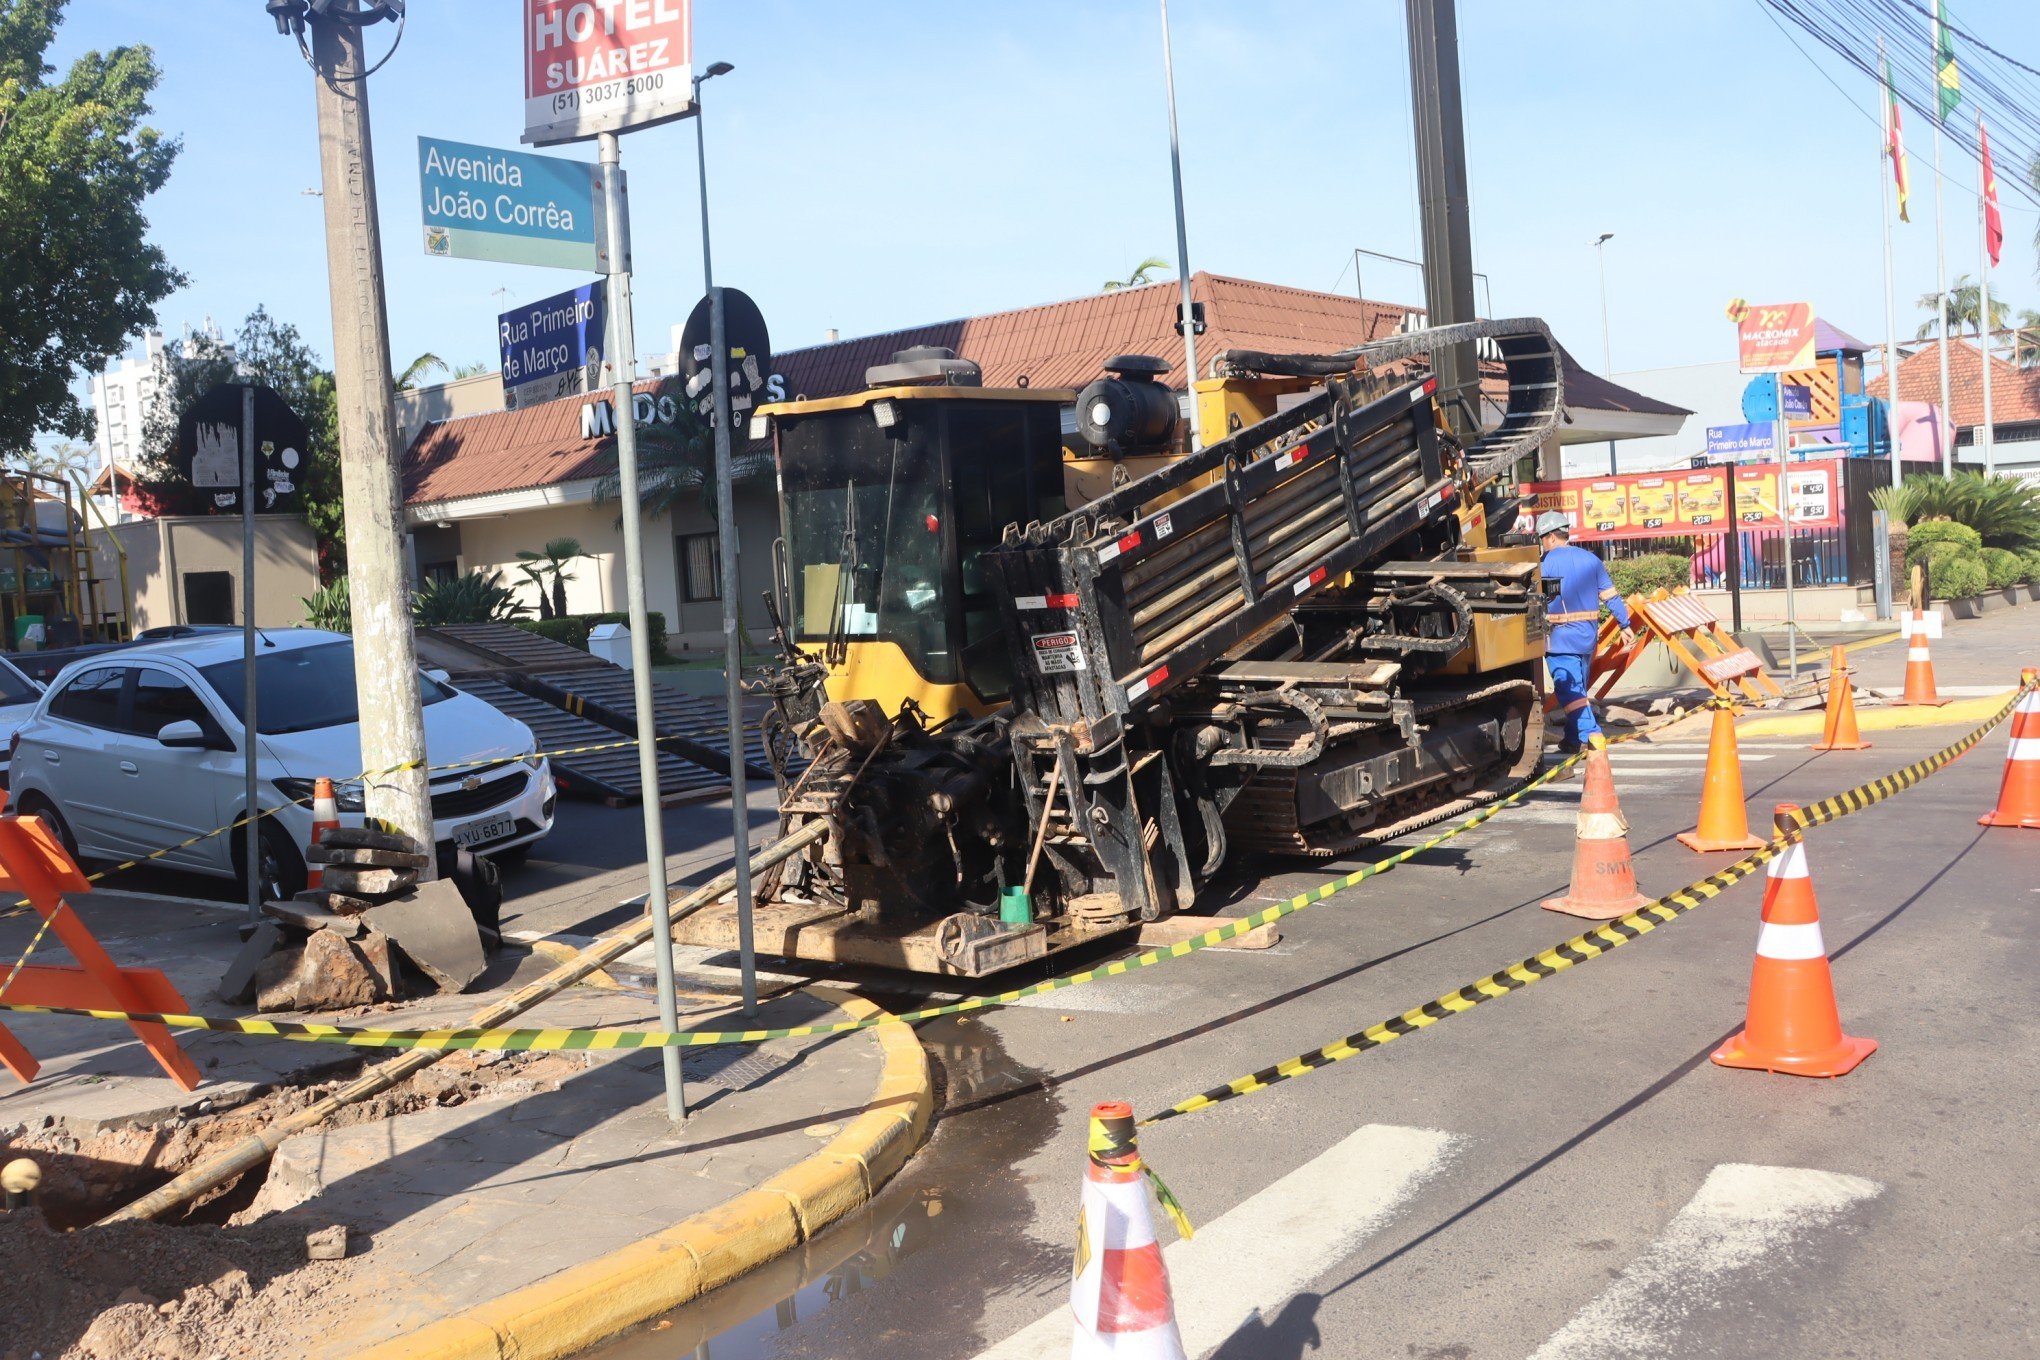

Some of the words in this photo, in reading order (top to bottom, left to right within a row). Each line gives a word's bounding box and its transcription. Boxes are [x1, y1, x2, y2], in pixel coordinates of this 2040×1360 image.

[536, 0, 679, 51] HOTEL
[546, 38, 670, 89] SUÁREZ
[552, 90, 580, 115] (51)
[585, 73, 664, 104] 3037.5000
[425, 146, 522, 188] Avenida
[428, 186, 487, 221] João
[494, 195, 574, 231] Corrêa
[500, 321, 528, 348] Rua
[531, 298, 594, 337] Primeiro
[1743, 328, 1799, 341] MACROMIX
[1755, 338, 1789, 347] atacado
[503, 354, 520, 381] de
[523, 344, 568, 375] Março
[1708, 429, 1723, 439] Rua
[1708, 439, 1738, 451] Primeiro
[1739, 438, 1748, 448] de
[1749, 437, 1772, 449] Março
[1875, 544, 1883, 584] ESPERA
[1041, 636, 1069, 647] PERIGO
